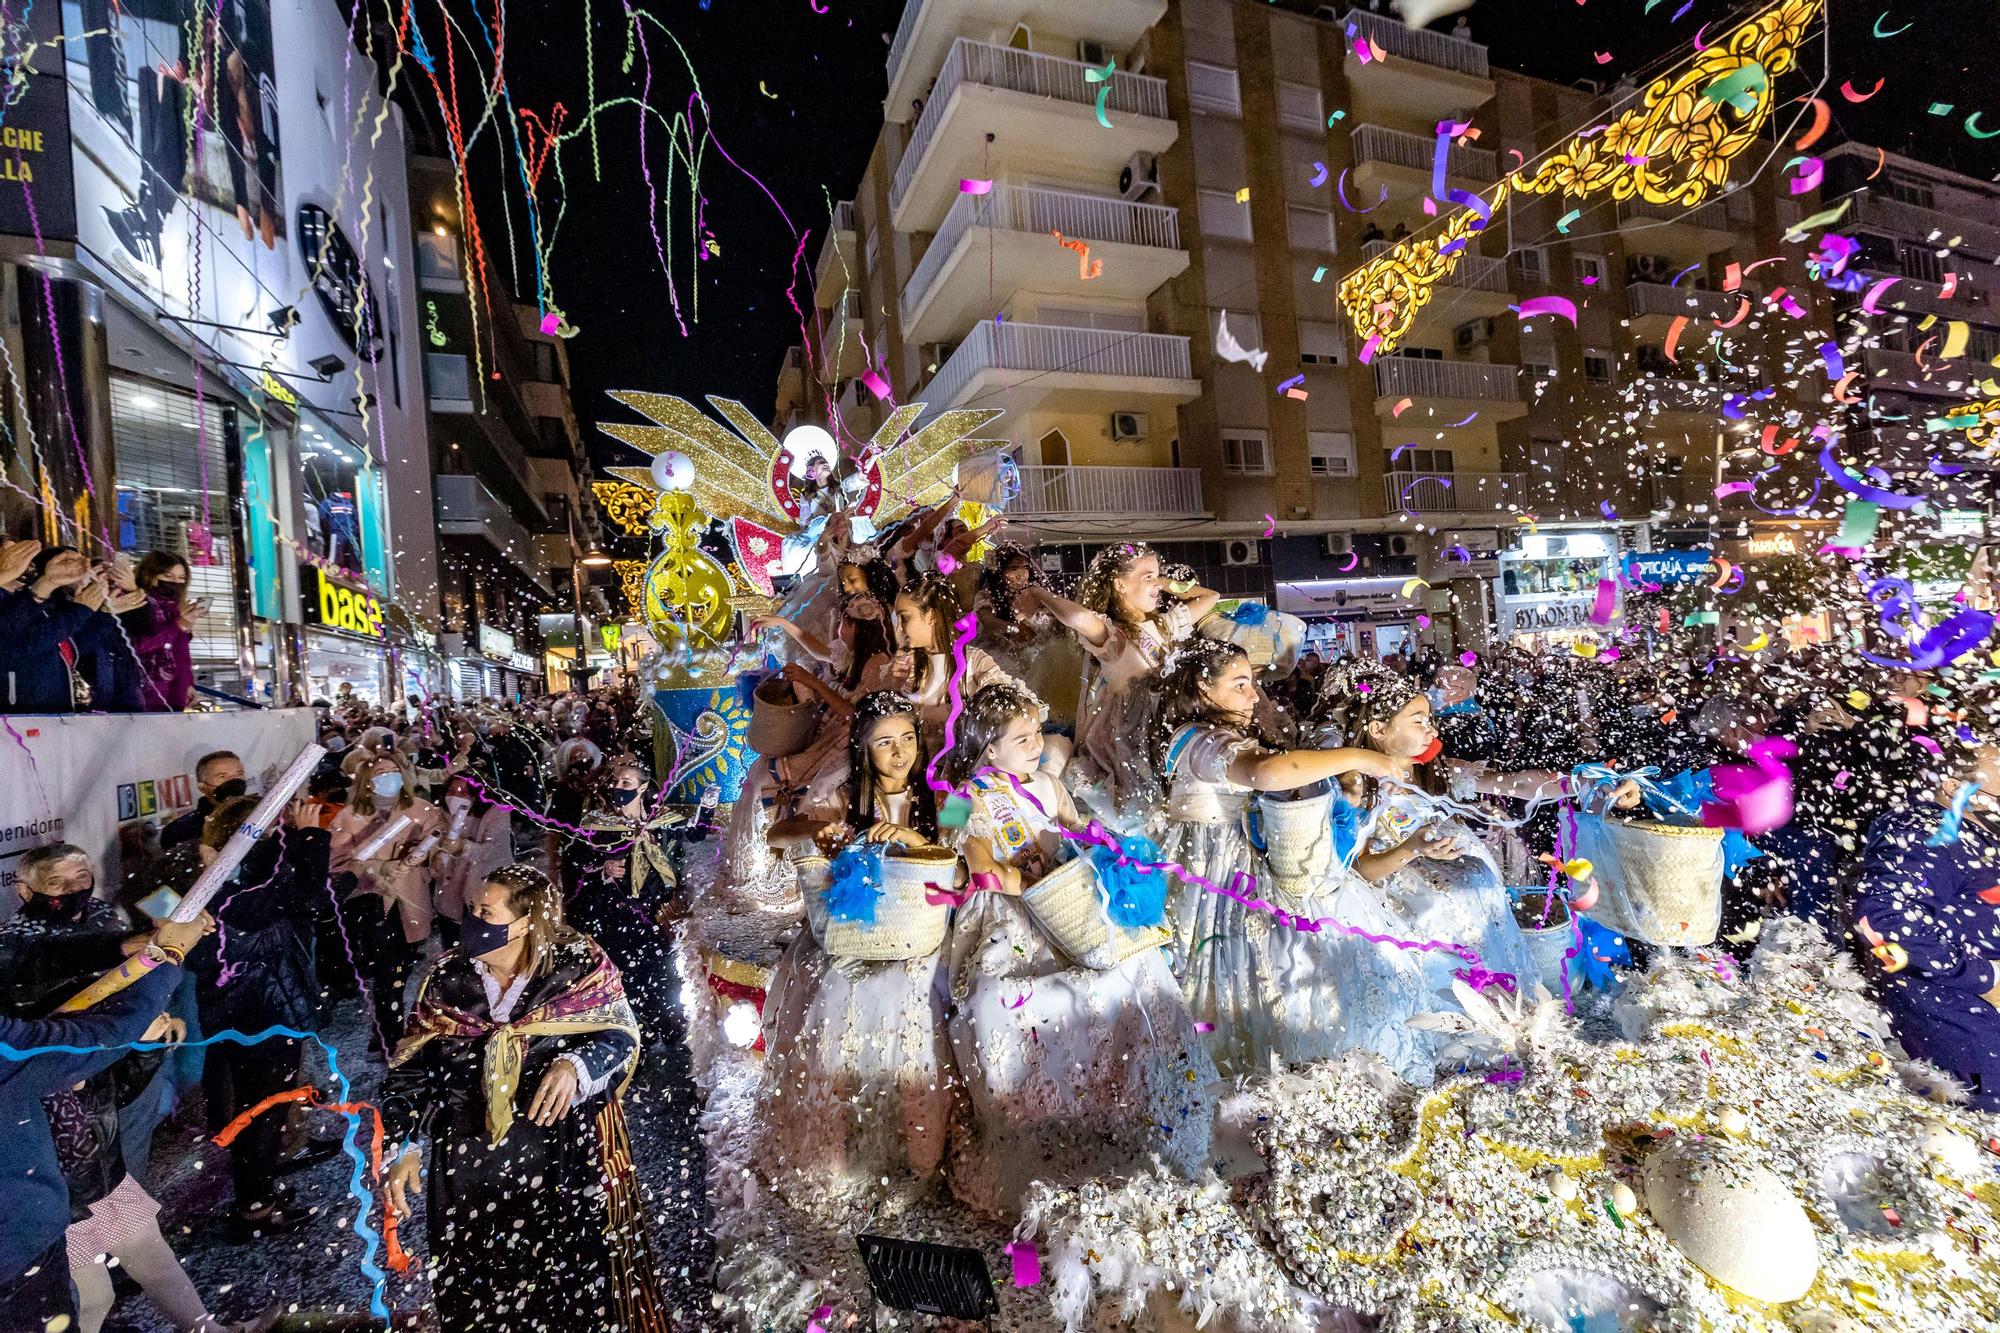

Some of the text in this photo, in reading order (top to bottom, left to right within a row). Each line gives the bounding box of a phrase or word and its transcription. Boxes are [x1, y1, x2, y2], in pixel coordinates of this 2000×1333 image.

[0, 127, 44, 152] CHE
[0, 158, 33, 183] LA
[318, 568, 383, 637] base
